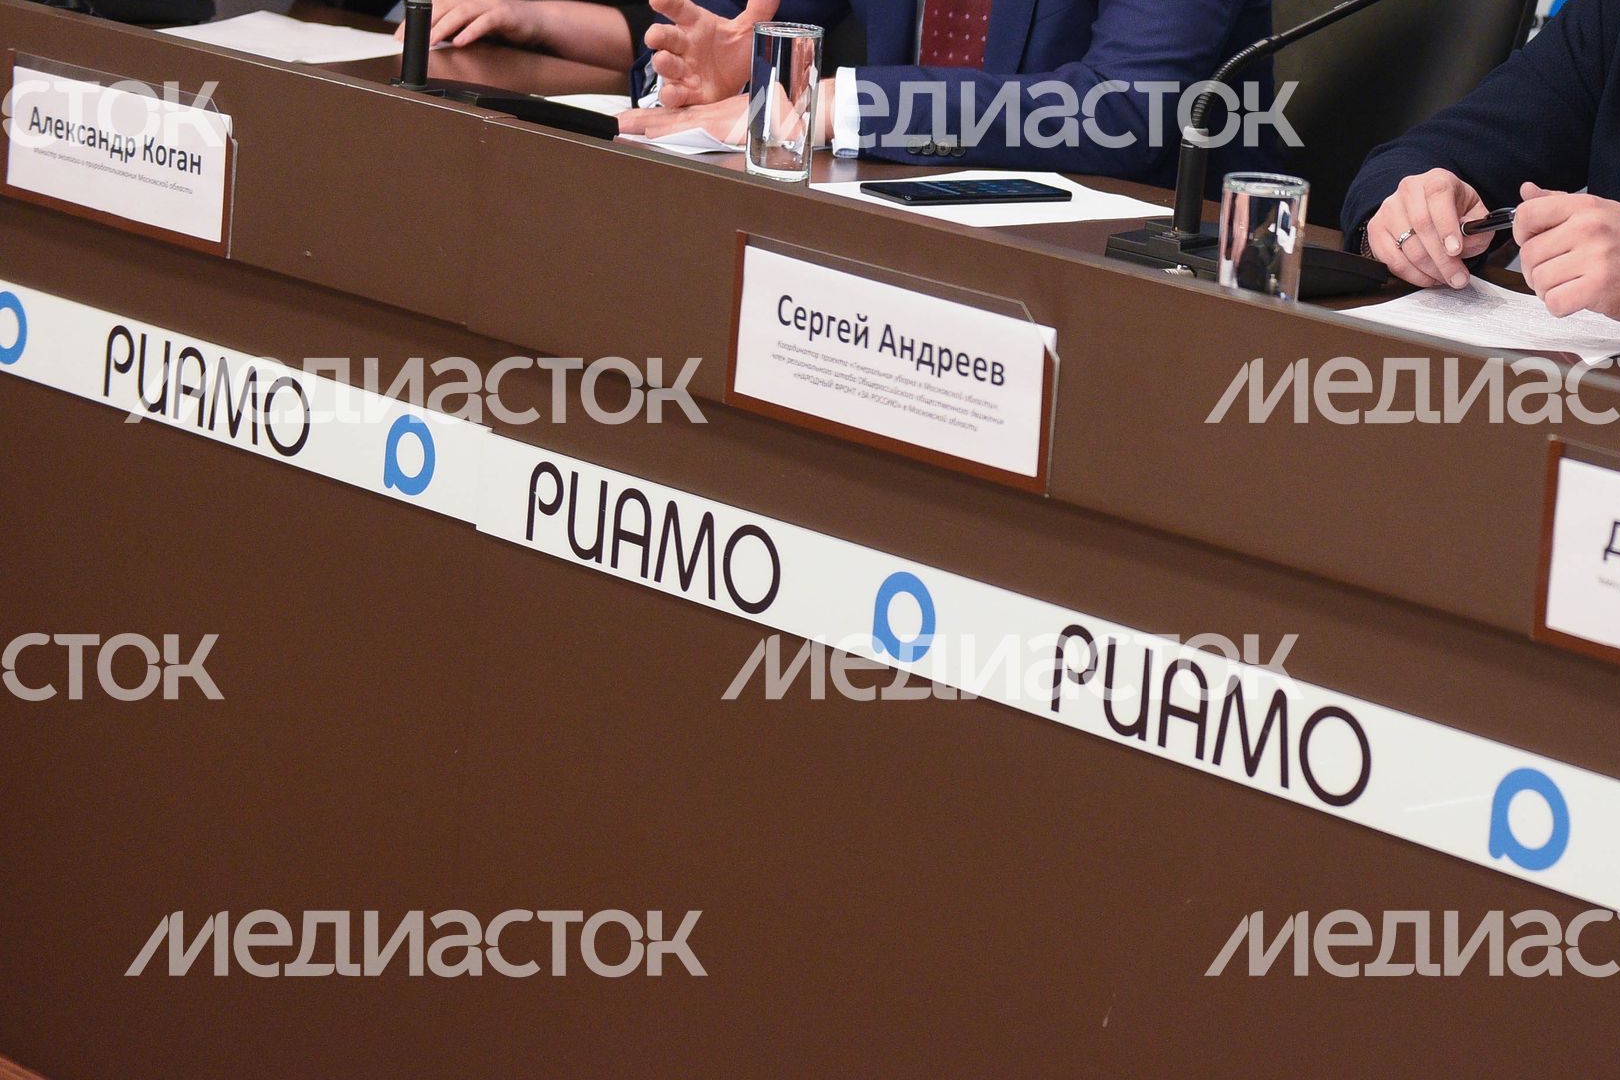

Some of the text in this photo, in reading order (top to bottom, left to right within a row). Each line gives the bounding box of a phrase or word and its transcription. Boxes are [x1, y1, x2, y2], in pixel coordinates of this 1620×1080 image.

[29, 106, 202, 175] Александр Коган
[777, 294, 1006, 387] Сергей Андреев
